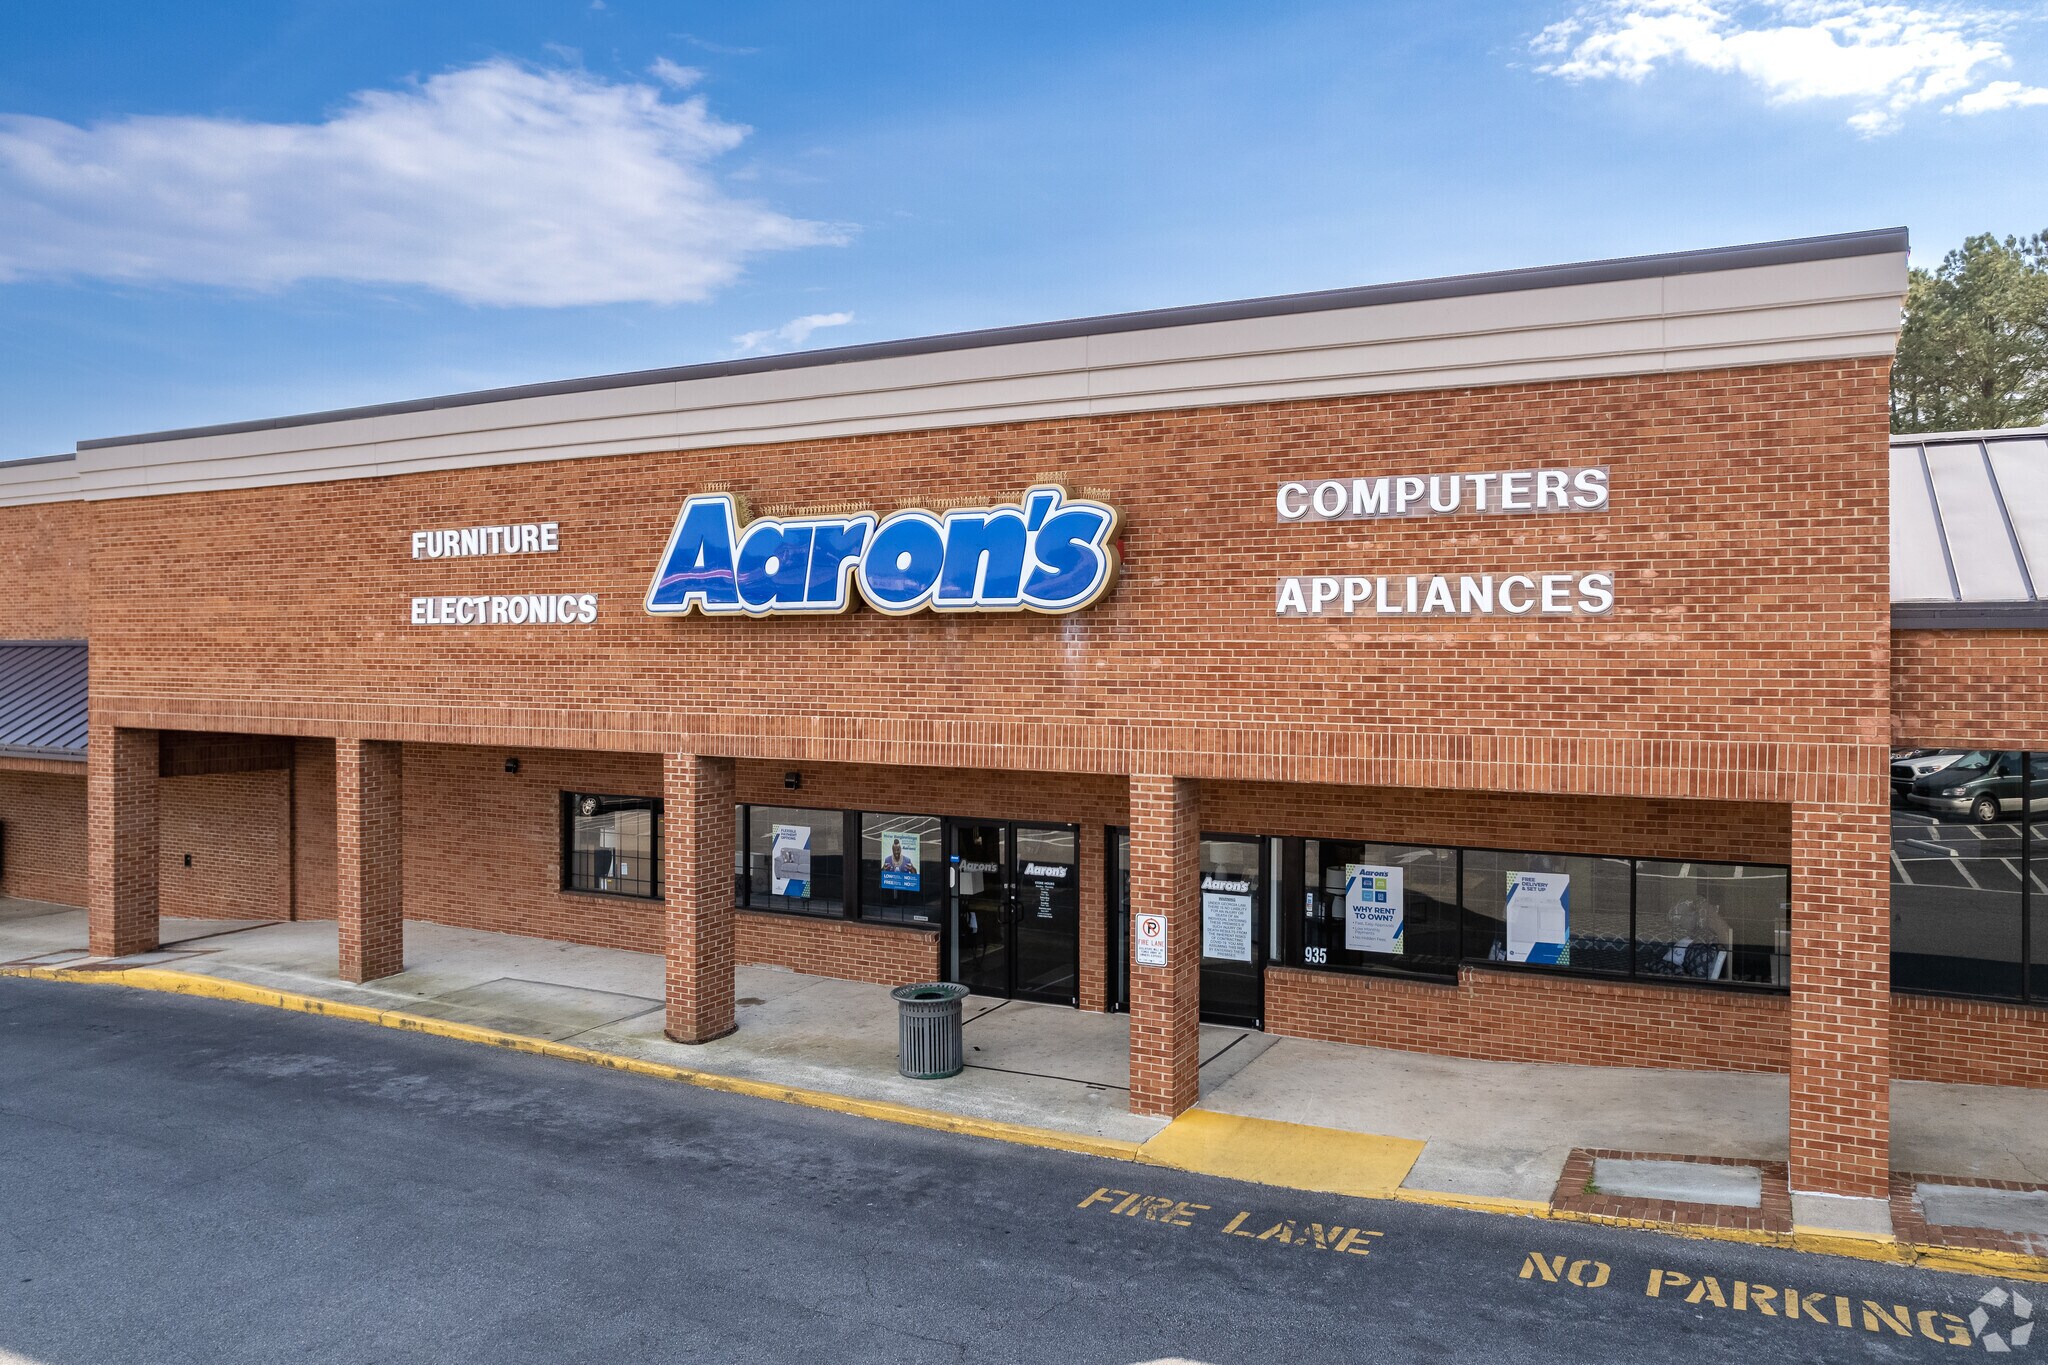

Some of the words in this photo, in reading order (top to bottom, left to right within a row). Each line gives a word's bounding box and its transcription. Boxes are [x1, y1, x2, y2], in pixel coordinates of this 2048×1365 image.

[1276, 468, 1608, 518] COMPUTERS
[412, 523, 559, 559] FURNITURE
[645, 487, 1118, 615] Aaron's
[411, 594, 598, 624] ELECTRONICS
[1276, 574, 1613, 614] APPLIANCES
[960, 860, 998, 872] Aaron's
[1024, 862, 1067, 878] Aaron's
[1359, 868, 1389, 877] Aaron's
[1201, 876, 1250, 892] Aaron's
[1375, 907, 1396, 915] RENT
[1305, 946, 1327, 964] 935
[1077, 1187, 1212, 1227] FIRE
[1222, 1211, 1385, 1255] LANE
[1519, 1252, 1610, 1288] NO
[1646, 1268, 1972, 1346] PARKING
